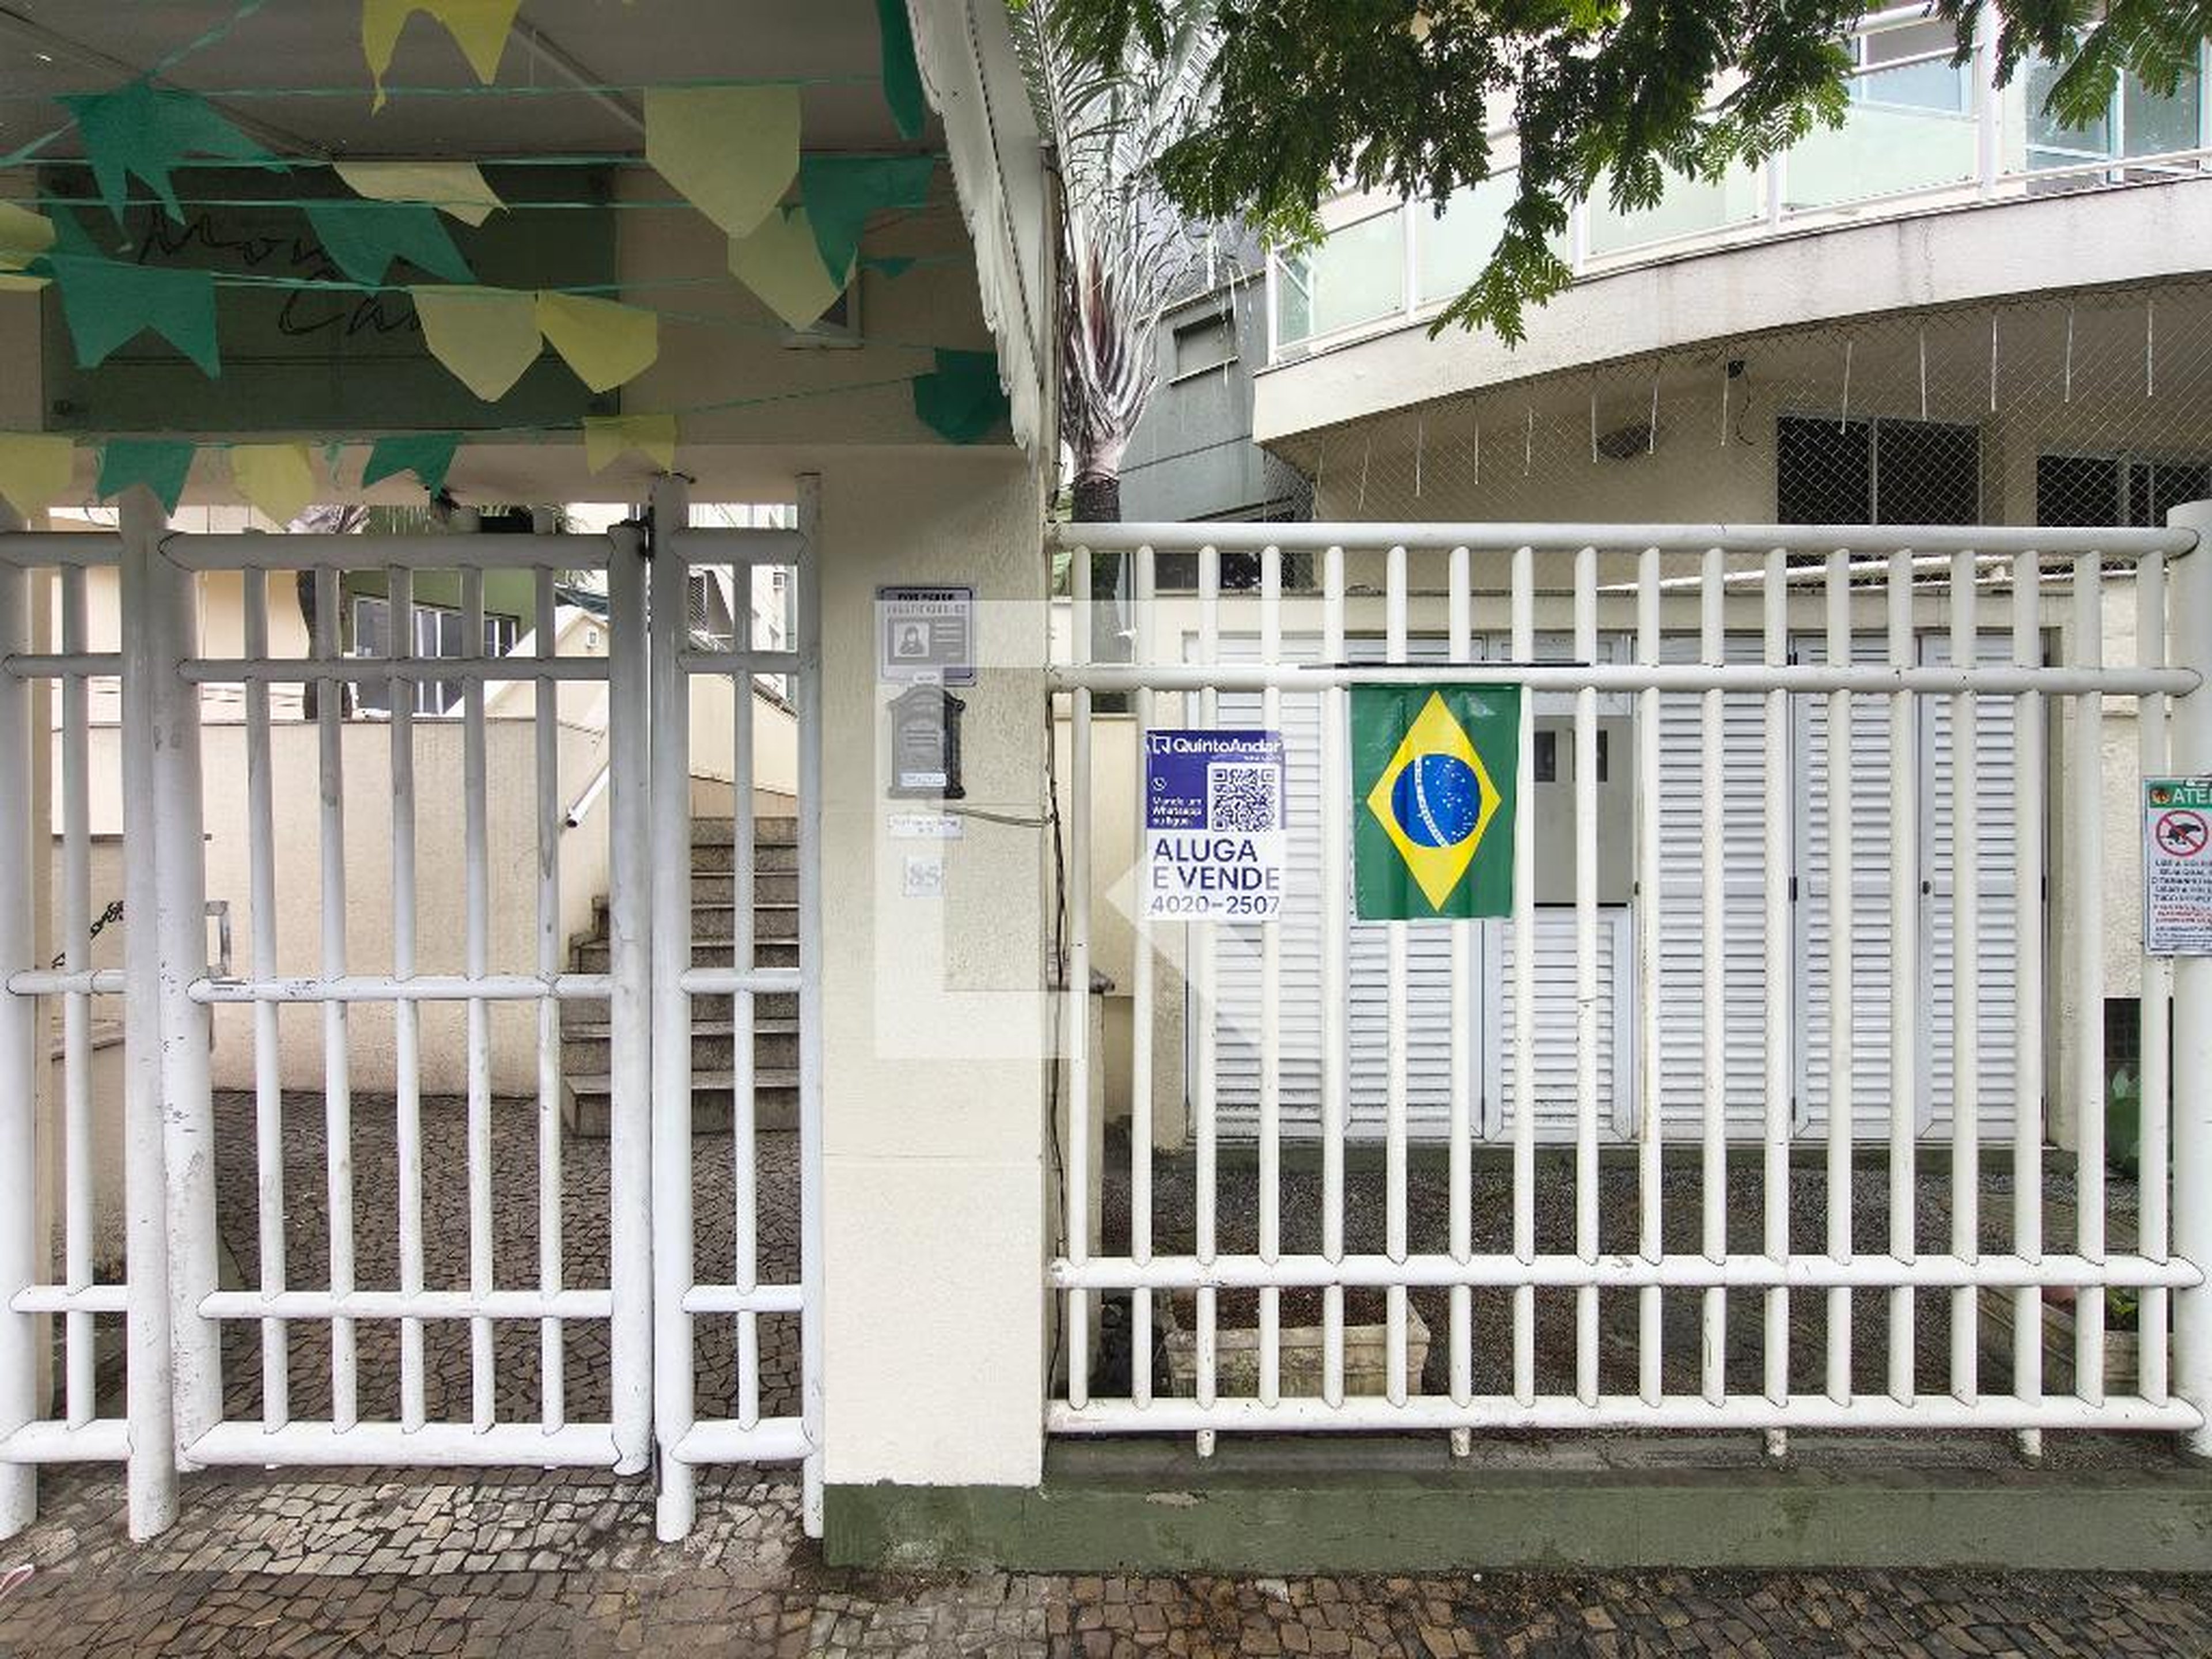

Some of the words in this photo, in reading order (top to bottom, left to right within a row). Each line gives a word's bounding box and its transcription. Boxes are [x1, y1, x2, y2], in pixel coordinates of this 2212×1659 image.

[1173, 738, 1282, 753] QuintoAndar
[2172, 787, 2212, 804] ATE
[1153, 839, 1258, 862] ALUGA
[1154, 866, 1169, 889] E
[1177, 866, 1280, 891] VENDE
[1152, 895, 1281, 914] 4020-2507
